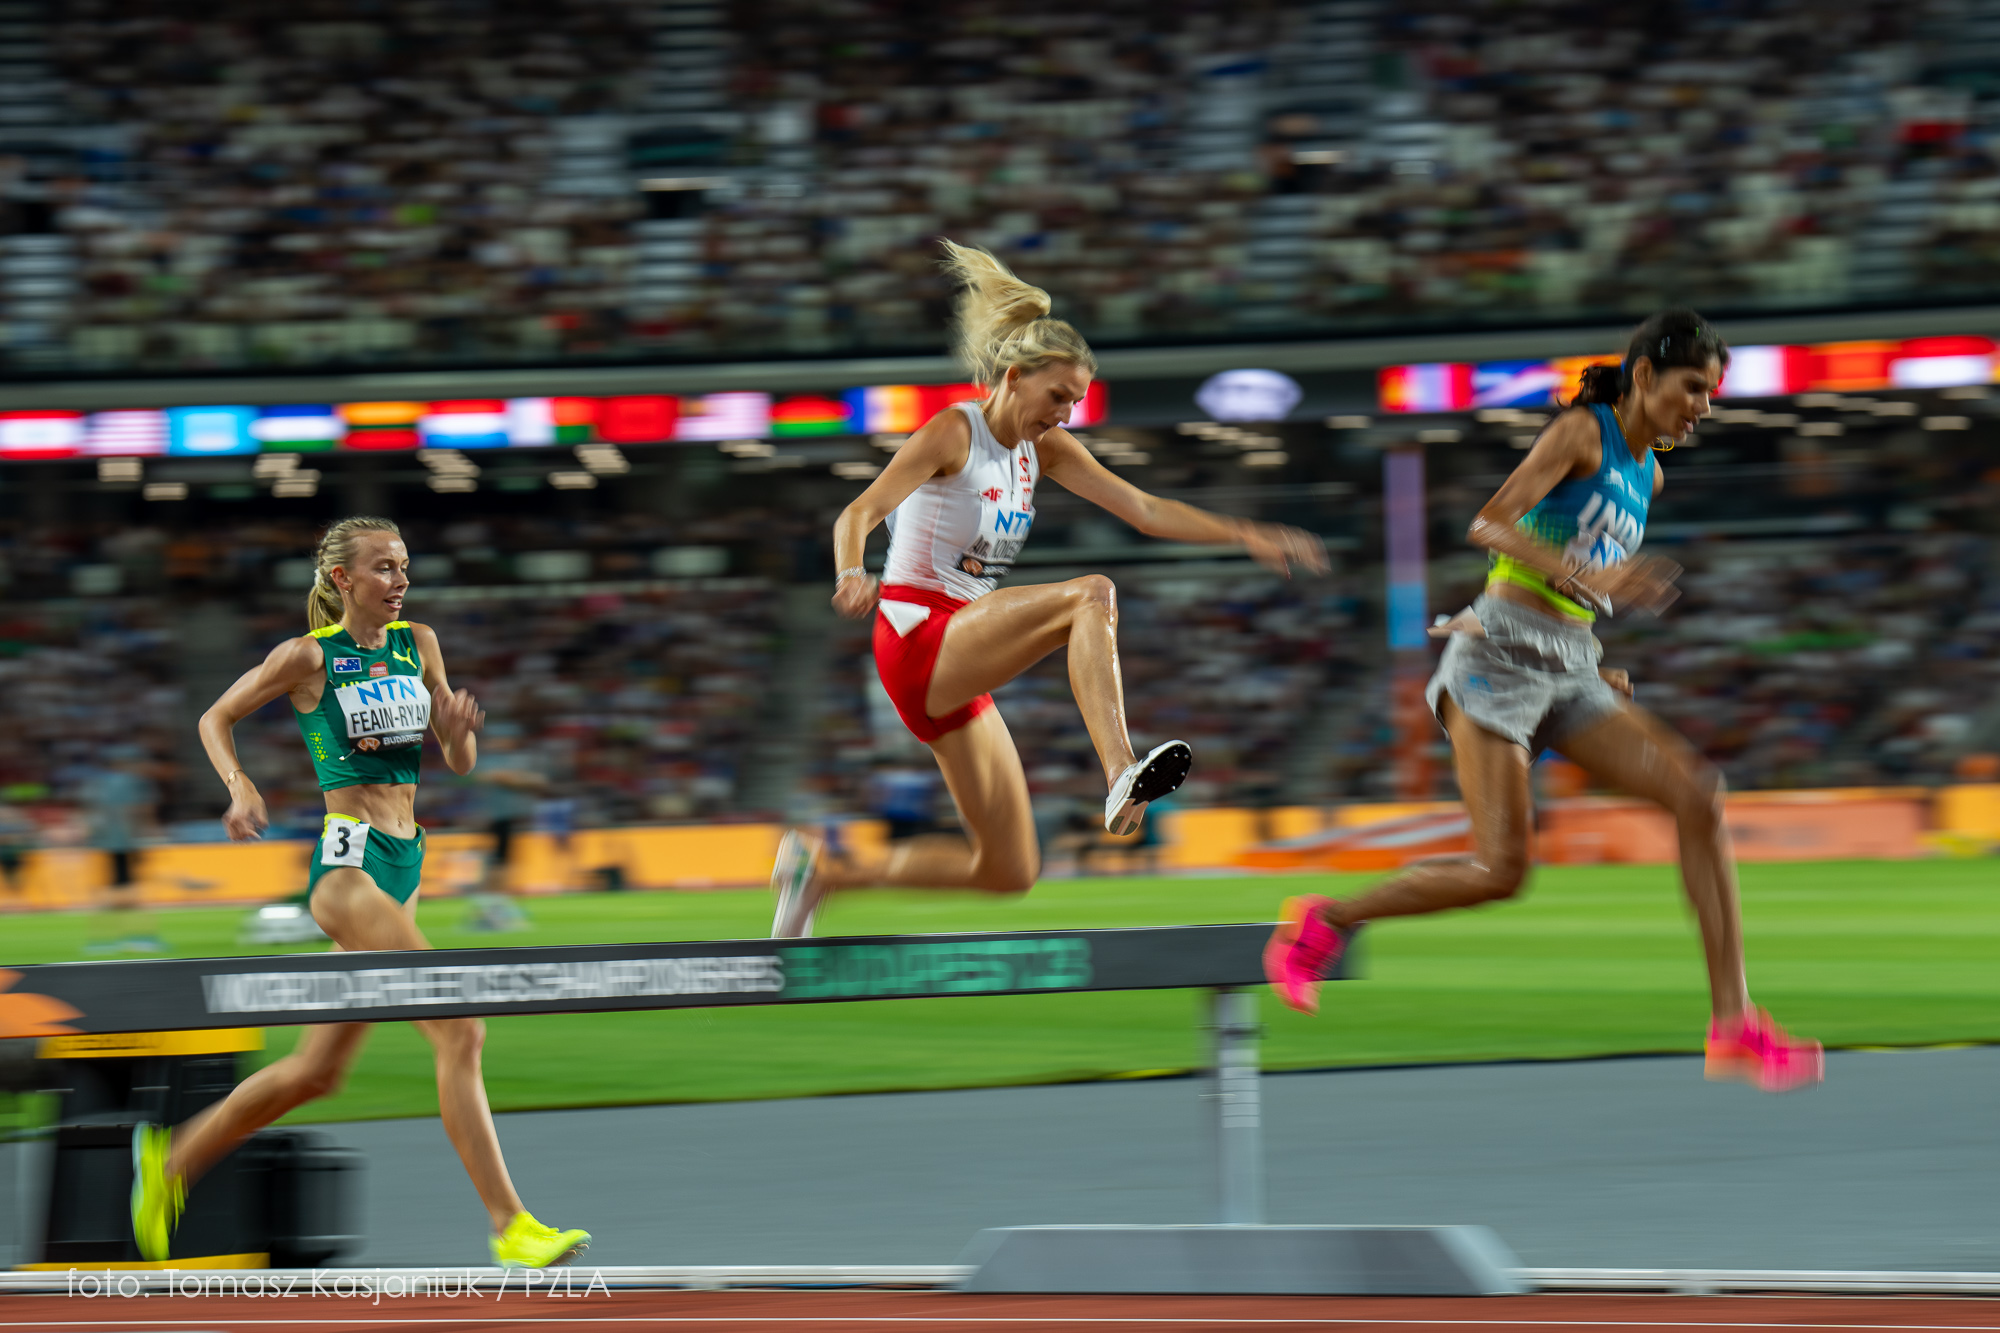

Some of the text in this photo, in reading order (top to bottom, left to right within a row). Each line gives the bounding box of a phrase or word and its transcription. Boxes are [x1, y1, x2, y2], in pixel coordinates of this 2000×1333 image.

[356, 678, 418, 707] NTN
[350, 703, 429, 735] FEAIN-RYAN
[334, 826, 351, 858] 3
